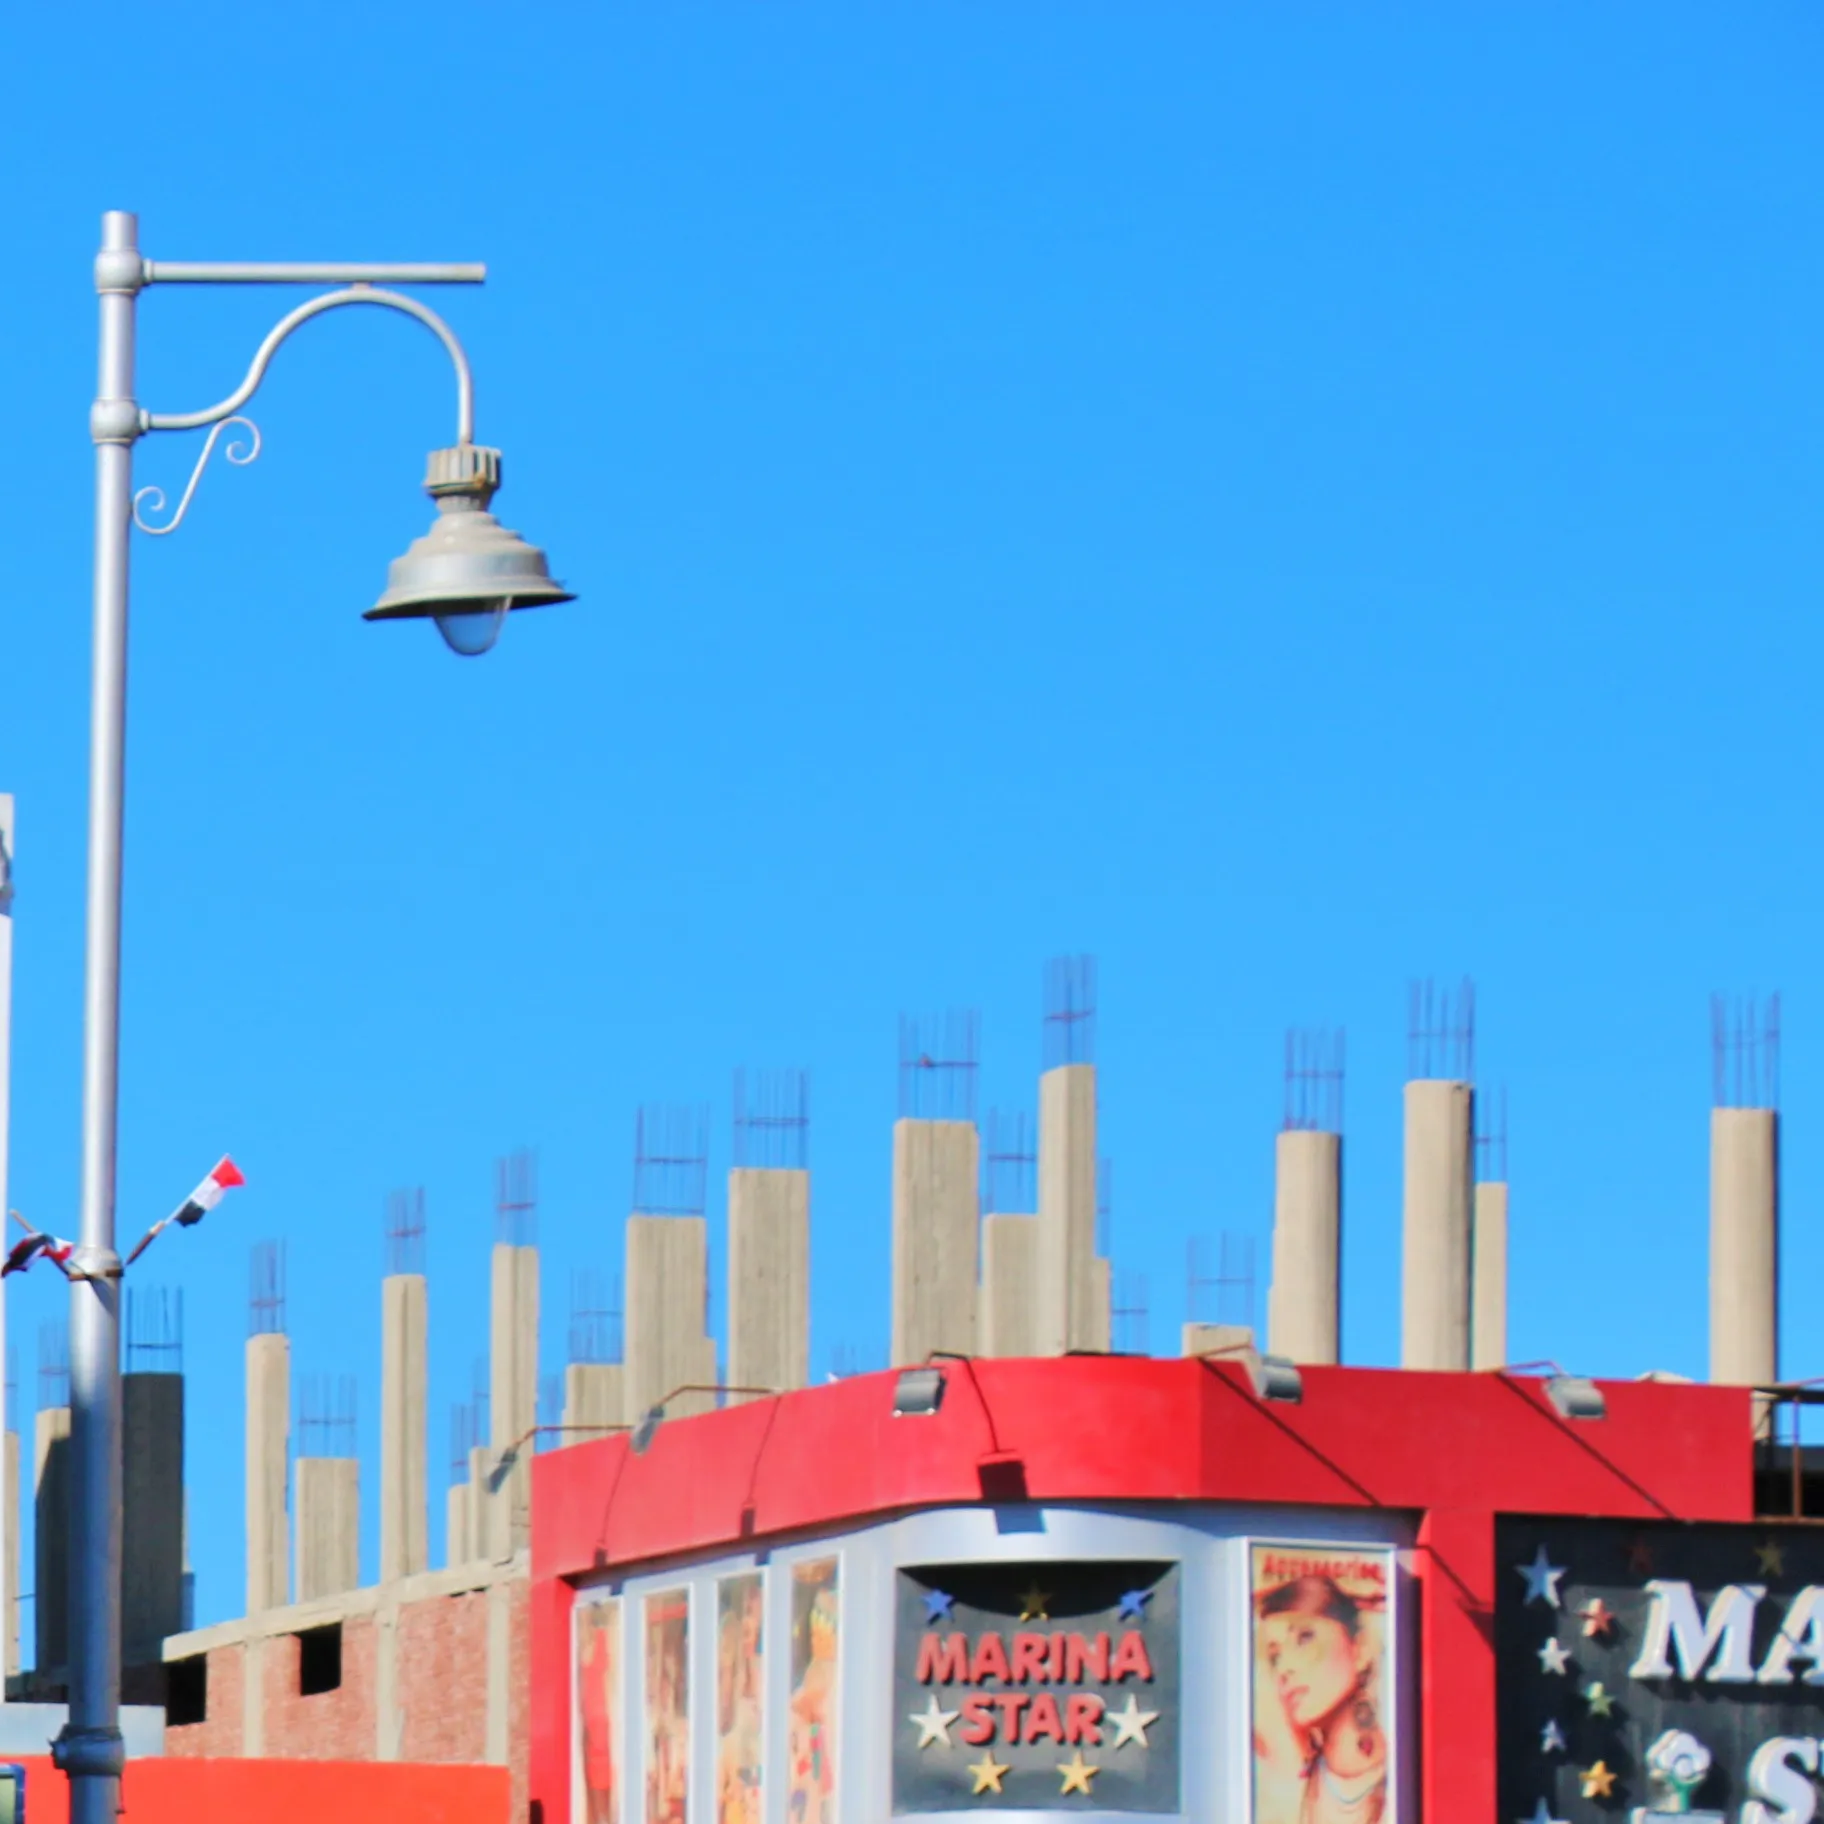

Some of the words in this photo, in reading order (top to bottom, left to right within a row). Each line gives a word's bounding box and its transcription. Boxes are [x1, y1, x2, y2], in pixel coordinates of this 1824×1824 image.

[1263, 1553, 1385, 1581] Accessories
[916, 1630, 1154, 1685] MARINA
[959, 1692, 1107, 1746] STAR
